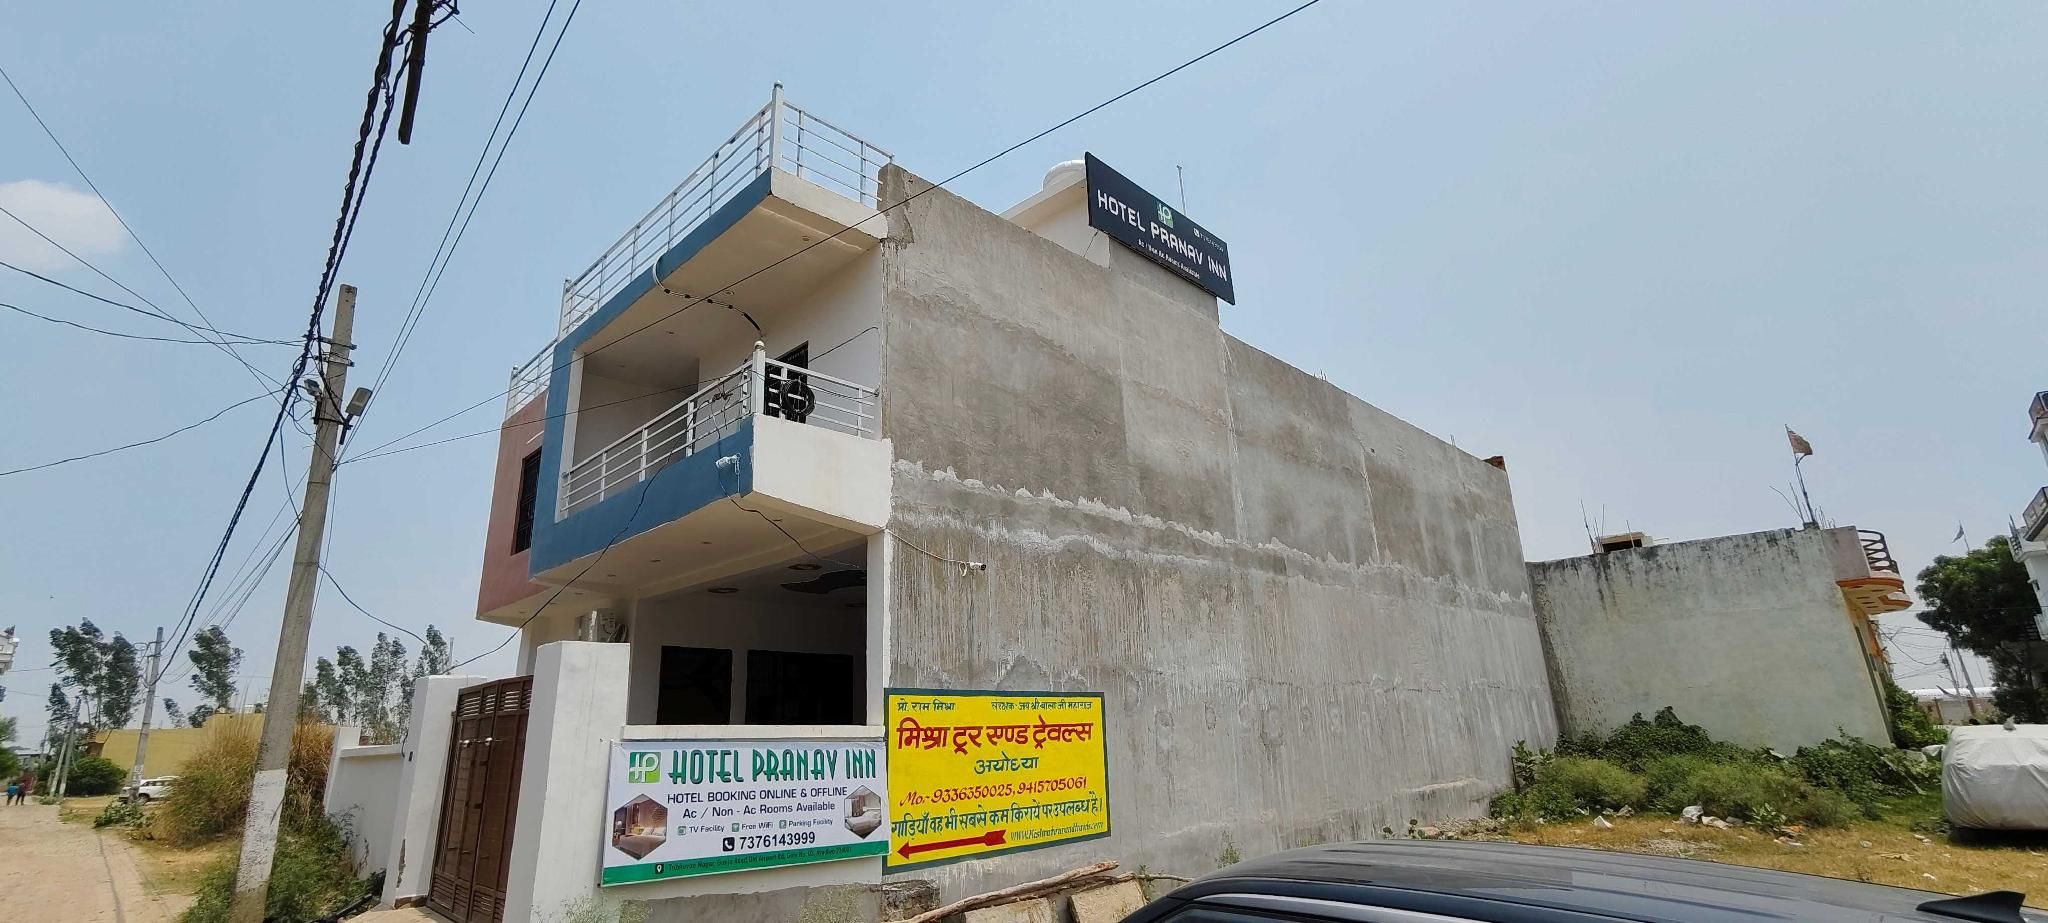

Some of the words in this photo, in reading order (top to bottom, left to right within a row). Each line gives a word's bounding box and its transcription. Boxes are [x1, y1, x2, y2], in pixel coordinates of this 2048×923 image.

[1097, 189, 1146, 232] HOTEL
[1150, 221, 1202, 265] PRANAV
[1208, 255, 1227, 282] INN
[911, 702, 931, 712] राम
[932, 699, 956, 711] मिश्रा
[896, 717, 950, 750] मिश्रा
[1032, 714, 1093, 749] ट्रेवल्स
[668, 750, 744, 784] HOTEL
[752, 749, 837, 782] PRANAV
[846, 749, 876, 779] INN
[974, 751, 1039, 774] अयोध्या
[668, 792, 703, 804] HOTEL
[708, 790, 756, 801] BOOKING
[760, 789, 797, 799] ONLINE
[800, 788, 807, 798] &
[811, 787, 847, 797] OFFLINE
[683, 808, 697, 818] Ac
[743, 805, 756, 815] Ac
[760, 804, 793, 814] Rooms
[797, 802, 835, 812] Available
[944, 808, 958, 830] भी
[959, 804, 987, 828] सबसे
[989, 808, 1009, 825] कम
[701, 825, 724, 833] Facility
[788, 820, 811, 828] Parking
[739, 832, 815, 850] 7376143999
